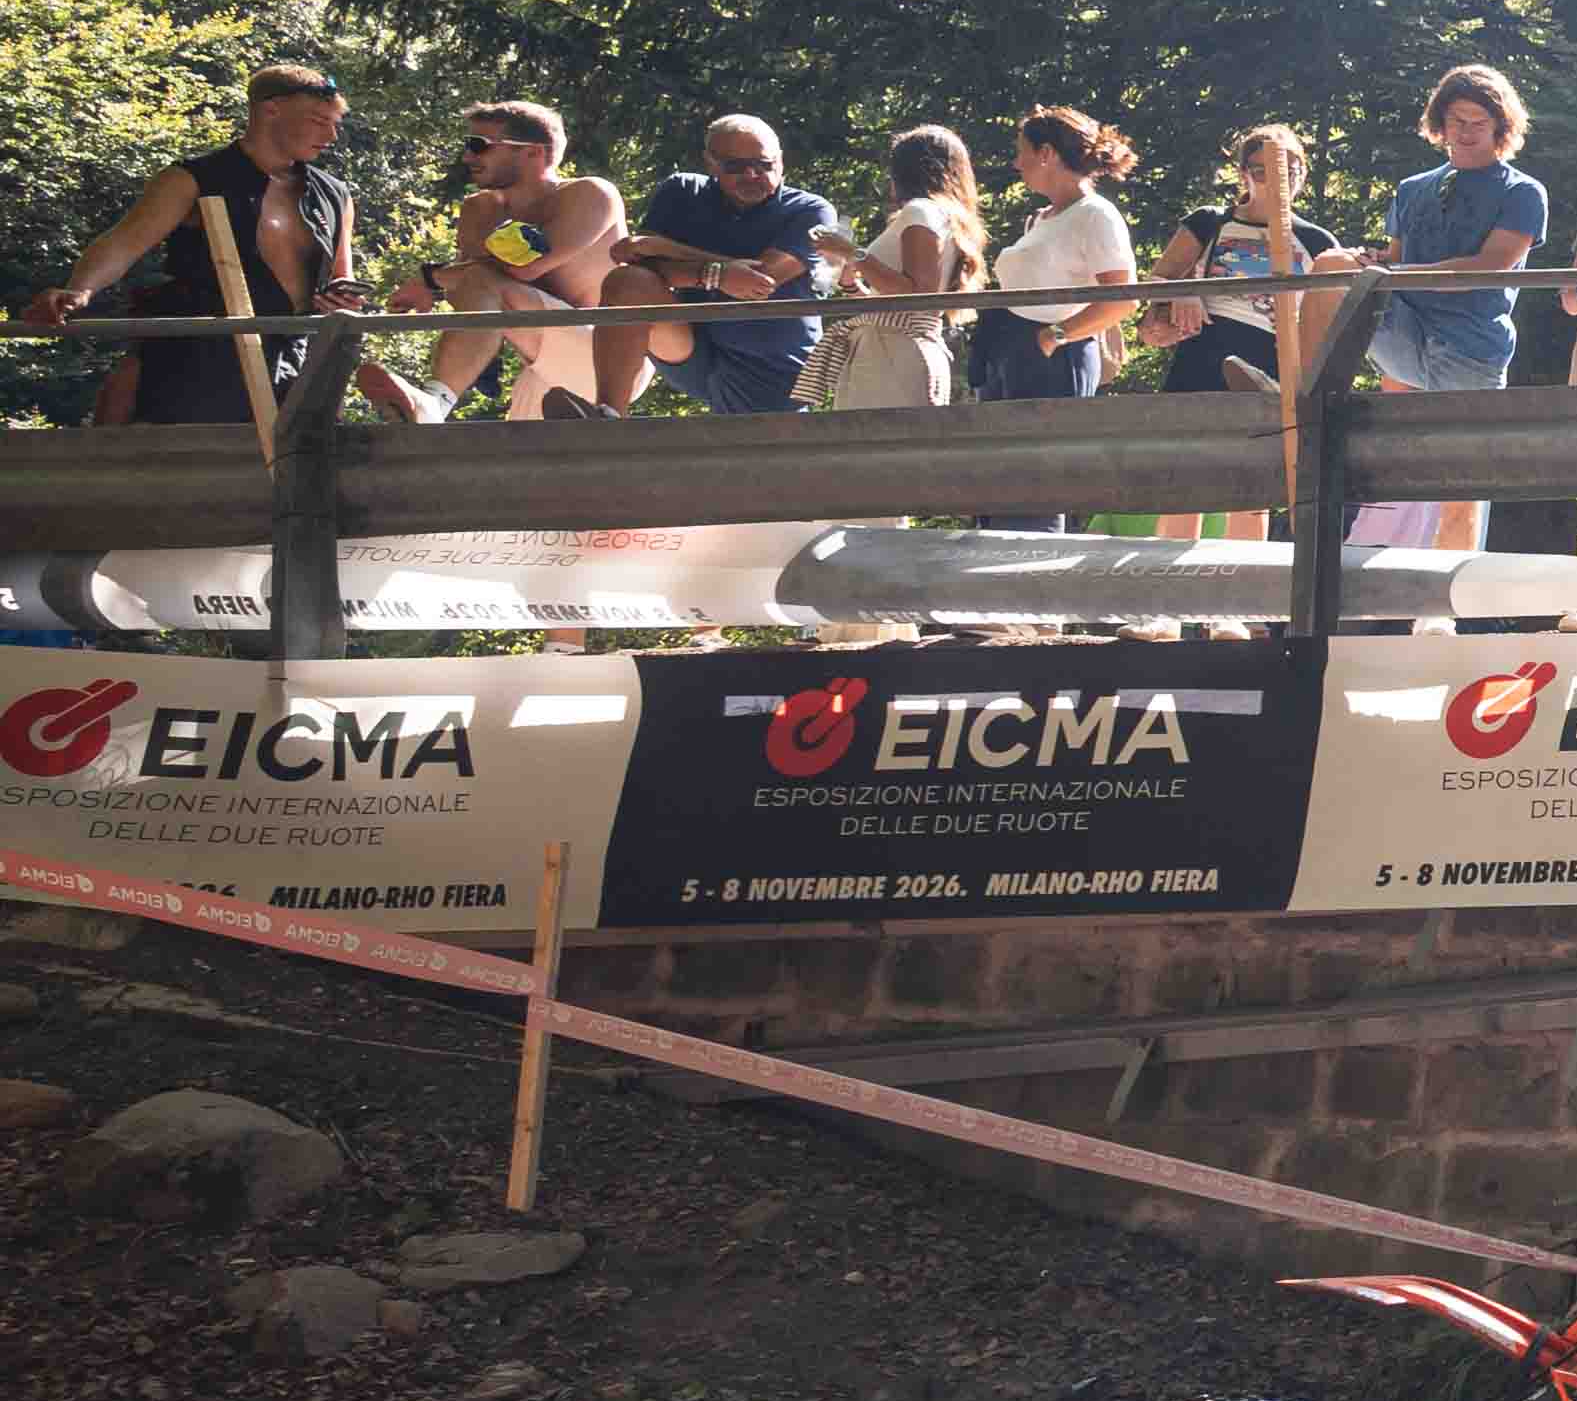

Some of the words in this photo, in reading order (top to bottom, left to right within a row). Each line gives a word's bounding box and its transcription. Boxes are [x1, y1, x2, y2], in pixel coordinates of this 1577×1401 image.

[139, 706, 475, 782] EICMA
[873, 694, 1190, 771] EICMA
[0, 784, 221, 814] SPOSIZIONE
[227, 793, 471, 817] INTERNAZIONALE
[753, 784, 940, 807] ESPOSIZIONE
[947, 778, 1188, 805] INTERNAZIONALE
[88, 820, 200, 844] DELLE
[207, 824, 281, 845] DUE
[287, 826, 385, 847] RUOTE
[839, 814, 928, 837] DELLE
[933, 813, 988, 835] DUE
[998, 811, 1091, 833] RUOTE
[681, 879, 699, 902] 5
[721, 878, 738, 902] 8
[747, 874, 886, 902] NOVEMBRE
[892, 874, 968, 899] 2026.
[985, 869, 1144, 898] MILANO-RHO
[1150, 868, 1218, 895] FIERA
[1375, 863, 1392, 887] 5
[1416, 863, 1434, 887] 8
[268, 884, 436, 910] MILANO-RHO
[442, 883, 507, 909] FIERA
